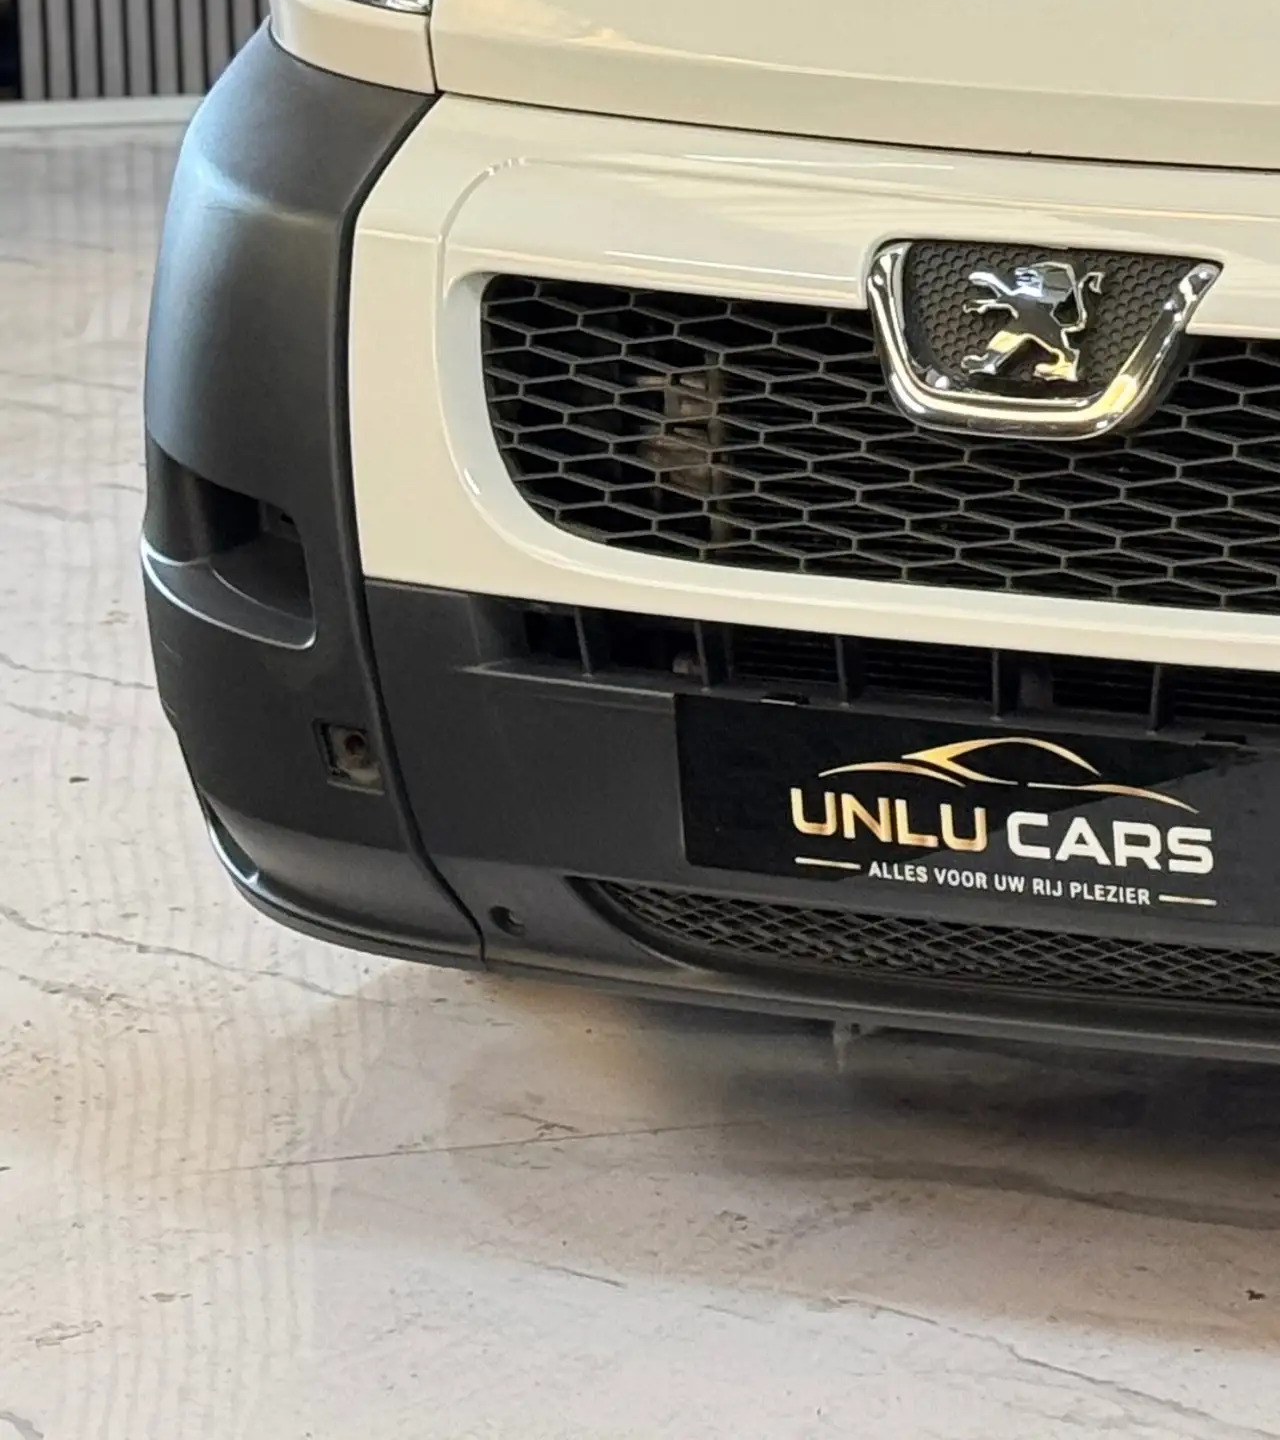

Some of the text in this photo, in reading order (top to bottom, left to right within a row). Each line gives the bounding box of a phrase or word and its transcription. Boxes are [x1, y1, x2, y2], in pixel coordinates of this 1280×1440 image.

[790, 787, 1214, 874] UNLU CARS
[868, 860, 1151, 905] ALLES VOOR UW RIJ PLEZIER
